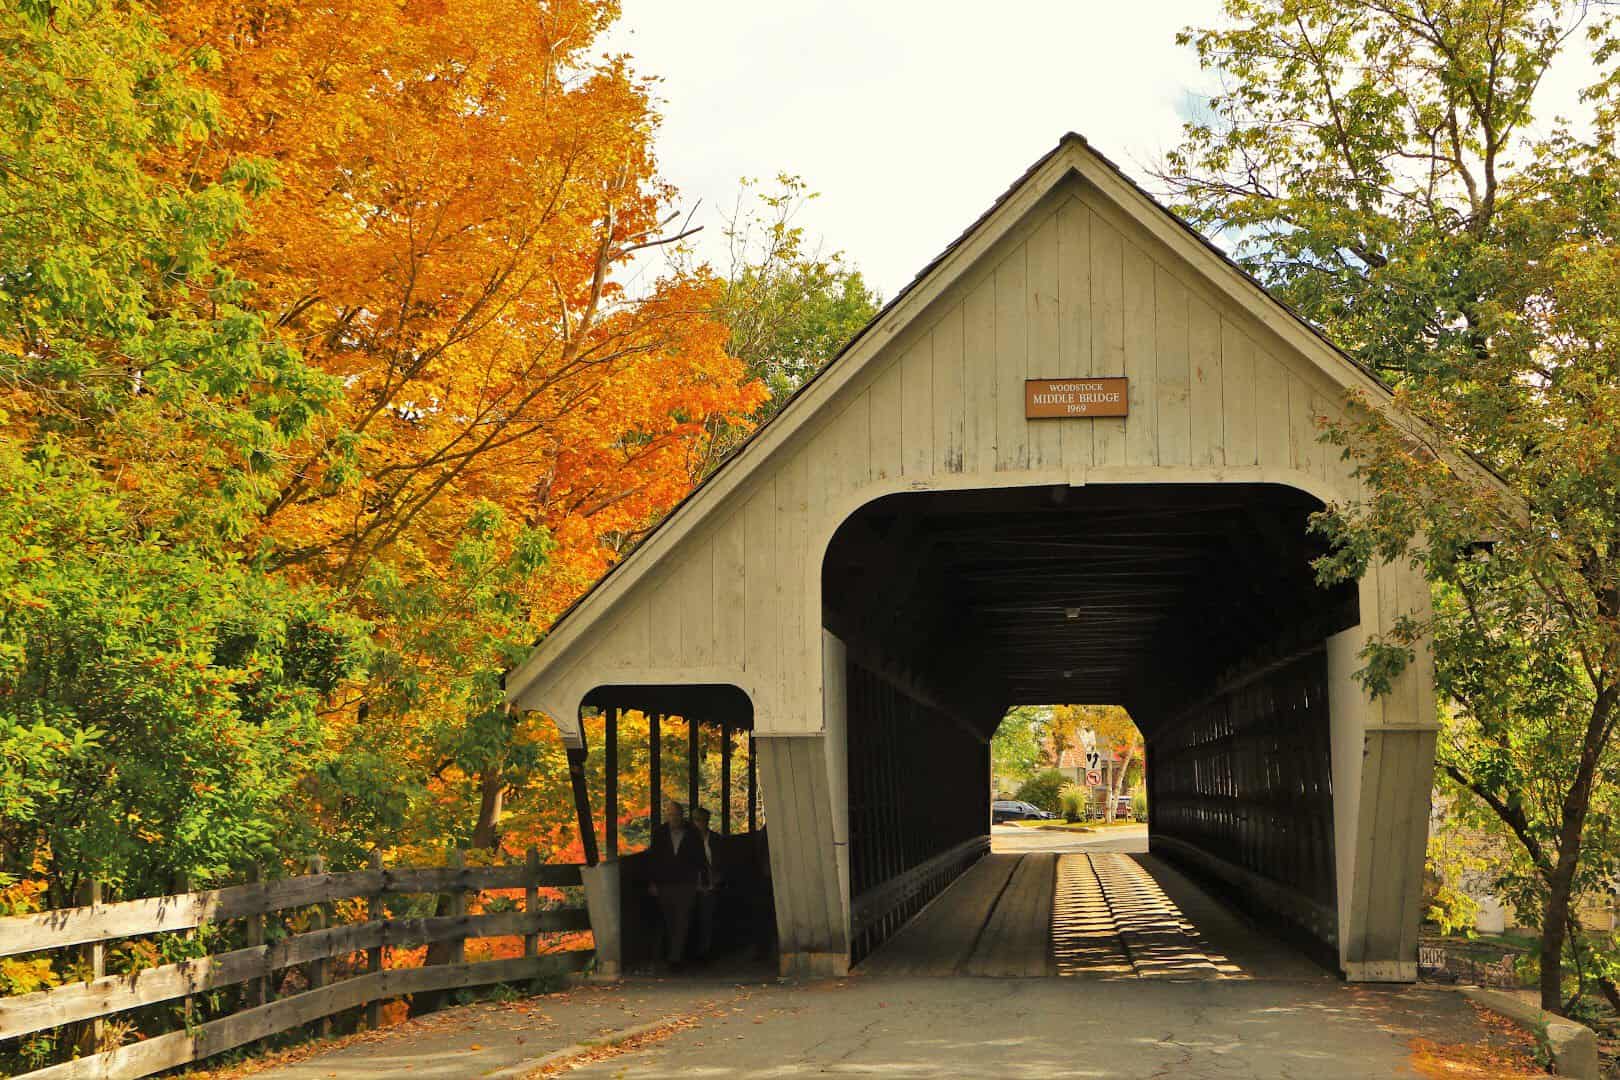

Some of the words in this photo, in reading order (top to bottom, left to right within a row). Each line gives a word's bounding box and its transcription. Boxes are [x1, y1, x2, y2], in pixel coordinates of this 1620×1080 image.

[1049, 383, 1104, 392] WOODSTOCK
[1033, 394, 1074, 404] MIDDLE
[1079, 392, 1120, 403] BRIDGE
[1067, 404, 1086, 413] 1969
